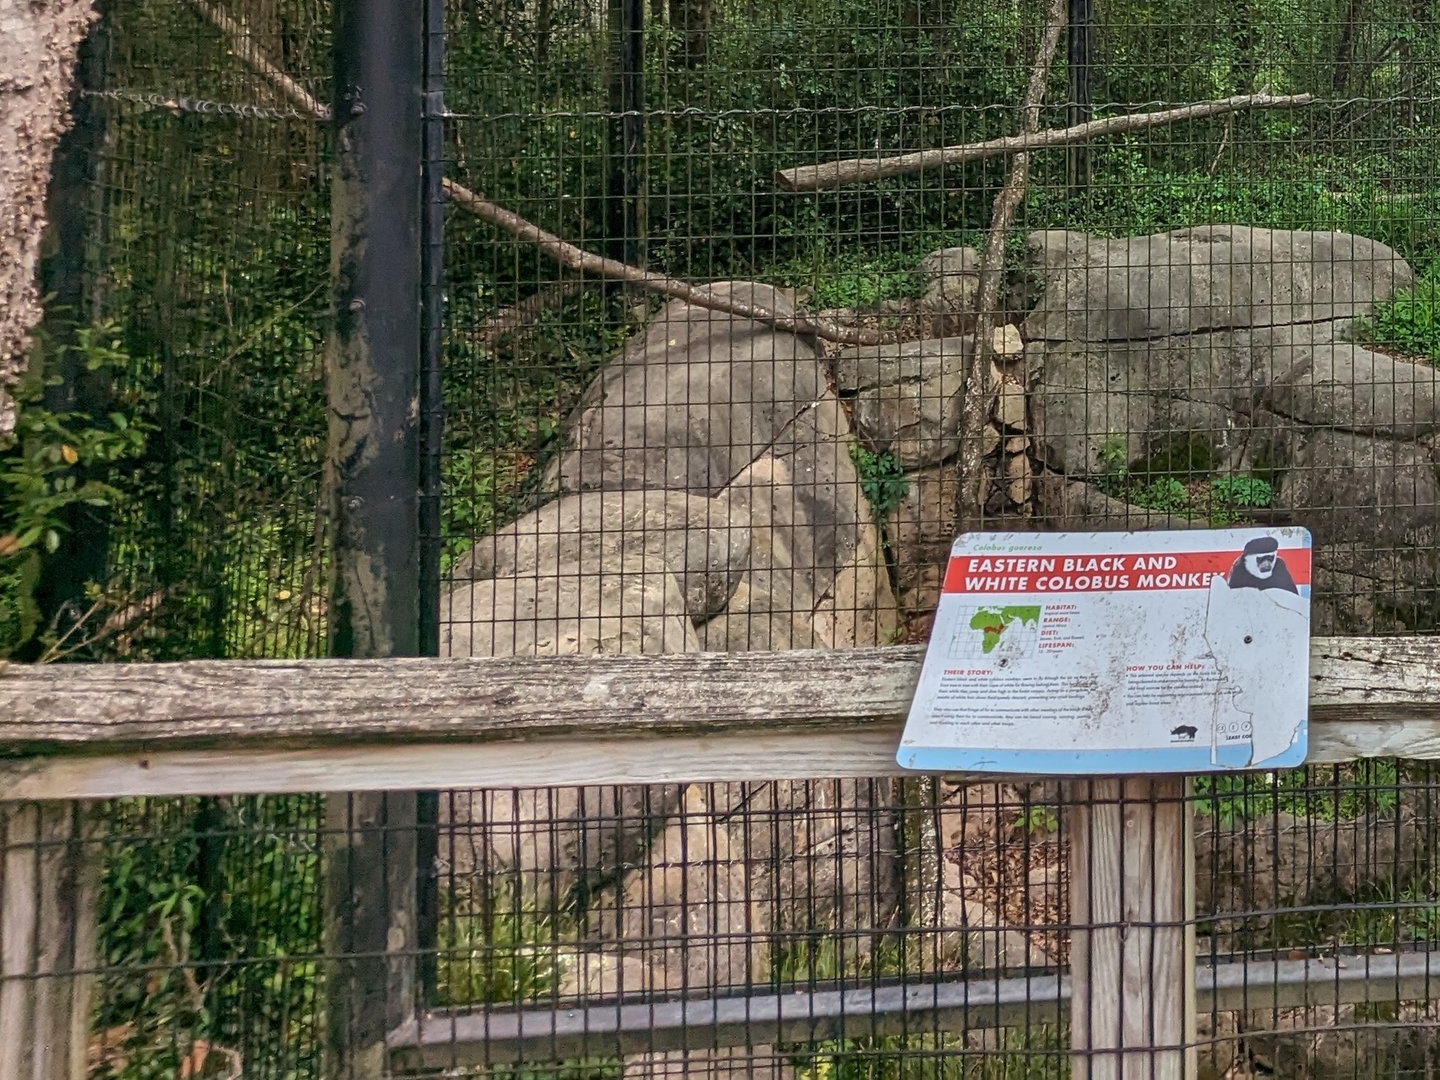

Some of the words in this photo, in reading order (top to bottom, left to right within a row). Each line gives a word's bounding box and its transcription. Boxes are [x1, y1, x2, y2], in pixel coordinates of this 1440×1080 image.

[972, 543, 1005, 552] Colobus
[1008, 544, 1042, 553] guereza
[967, 558, 1055, 573] EASTERN
[1062, 557, 1126, 572] BLACK
[1132, 556, 1177, 570] AND
[964, 576, 1028, 591] WHITE
[1035, 574, 1130, 590] COLOBUS
